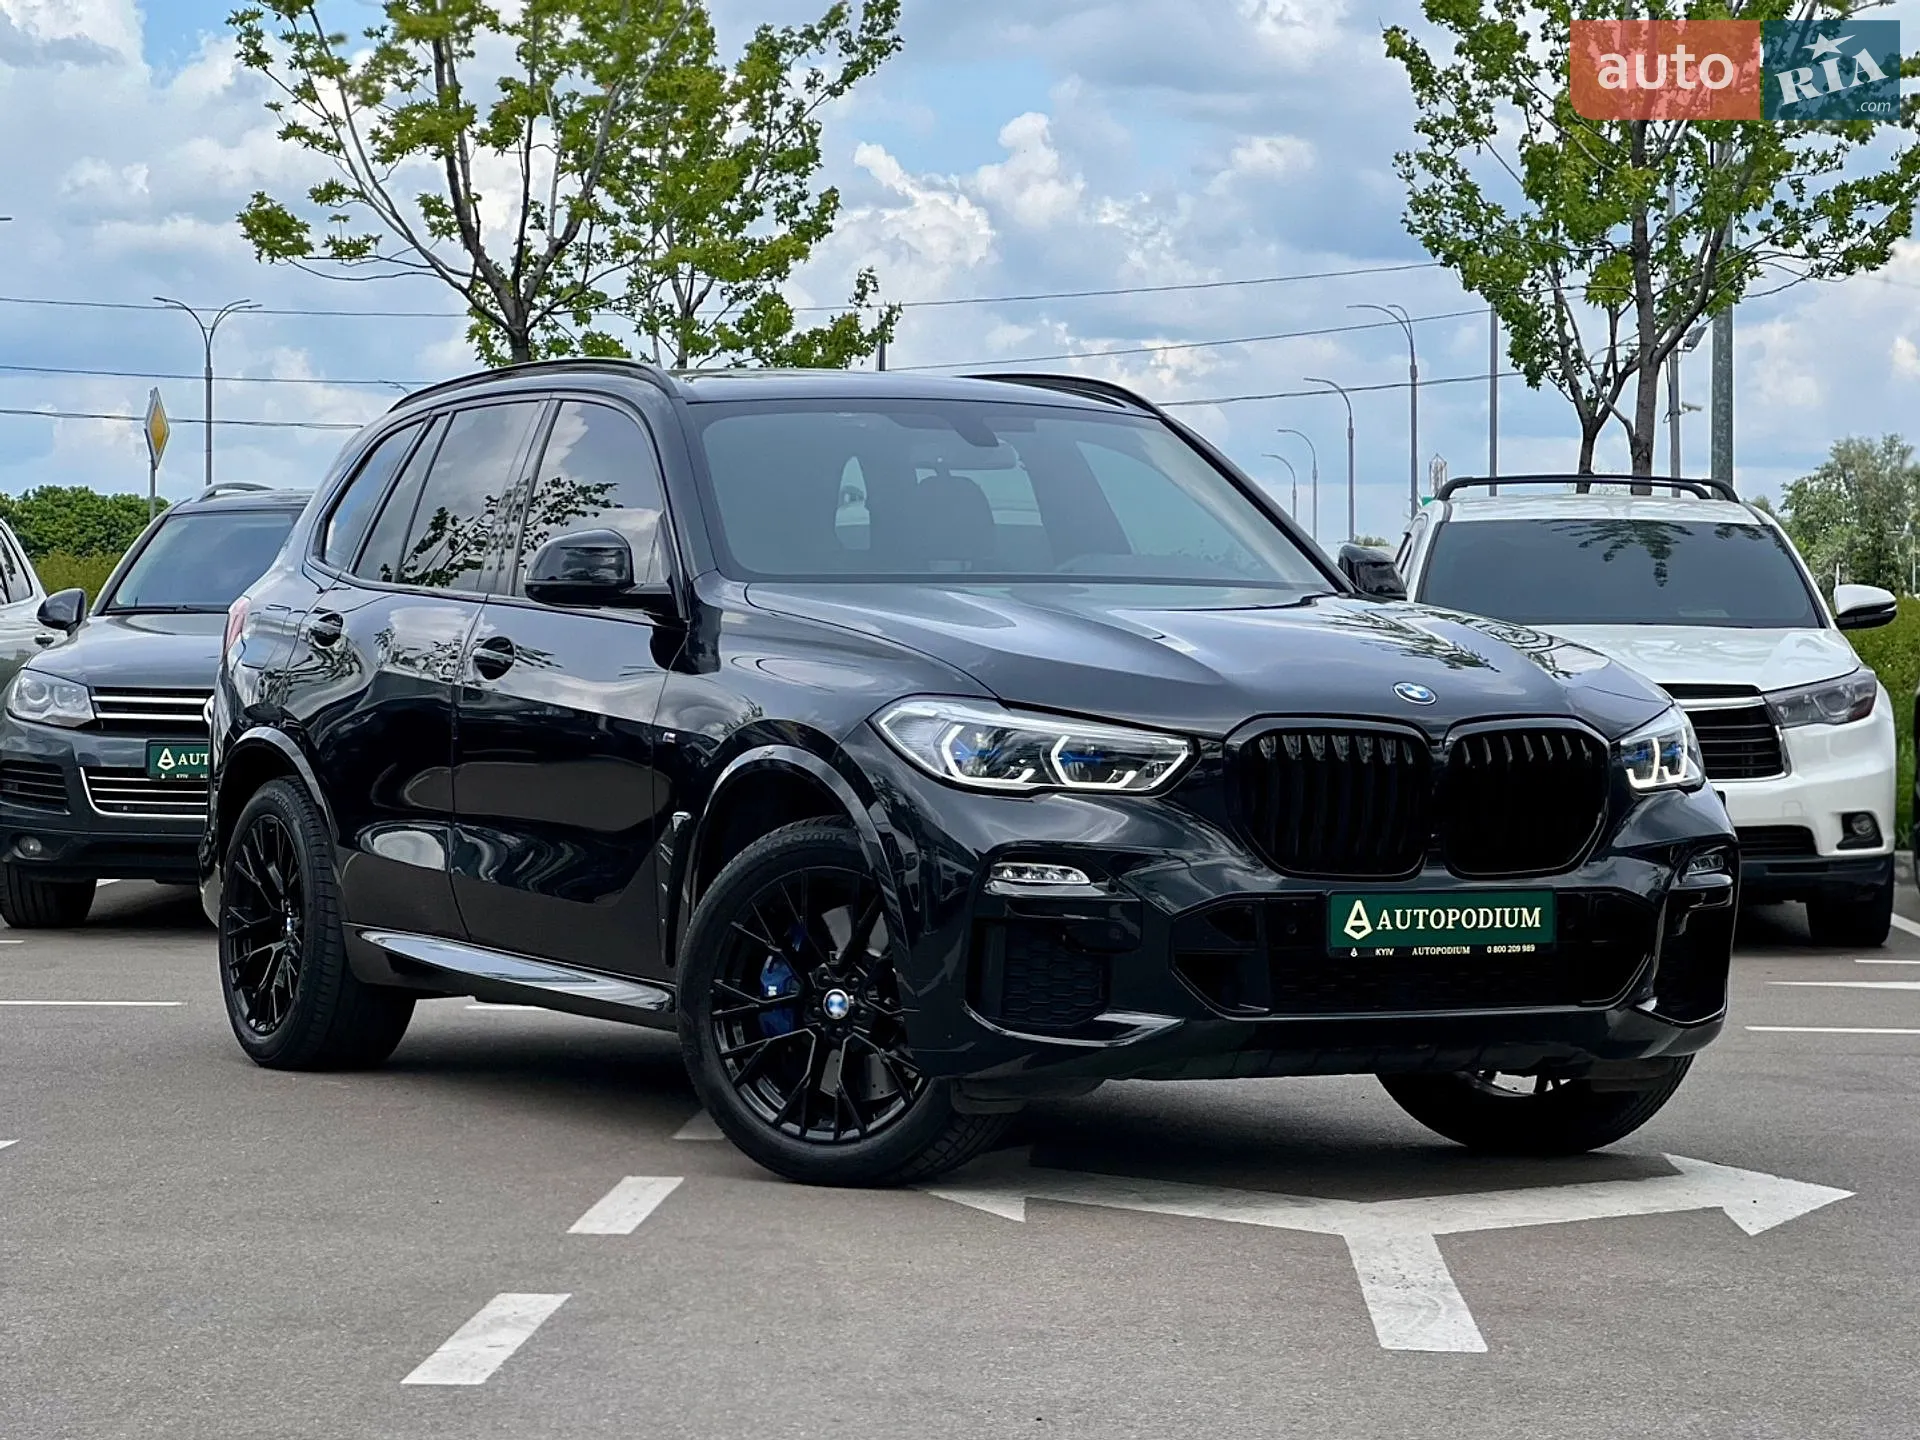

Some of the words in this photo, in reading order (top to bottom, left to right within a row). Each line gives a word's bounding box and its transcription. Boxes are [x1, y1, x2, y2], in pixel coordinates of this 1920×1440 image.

[1376, 907, 1541, 930] AUTOPODIUM
[1375, 948, 1394, 956] KYIV
[1412, 946, 1470, 956] AUTOPODIUM
